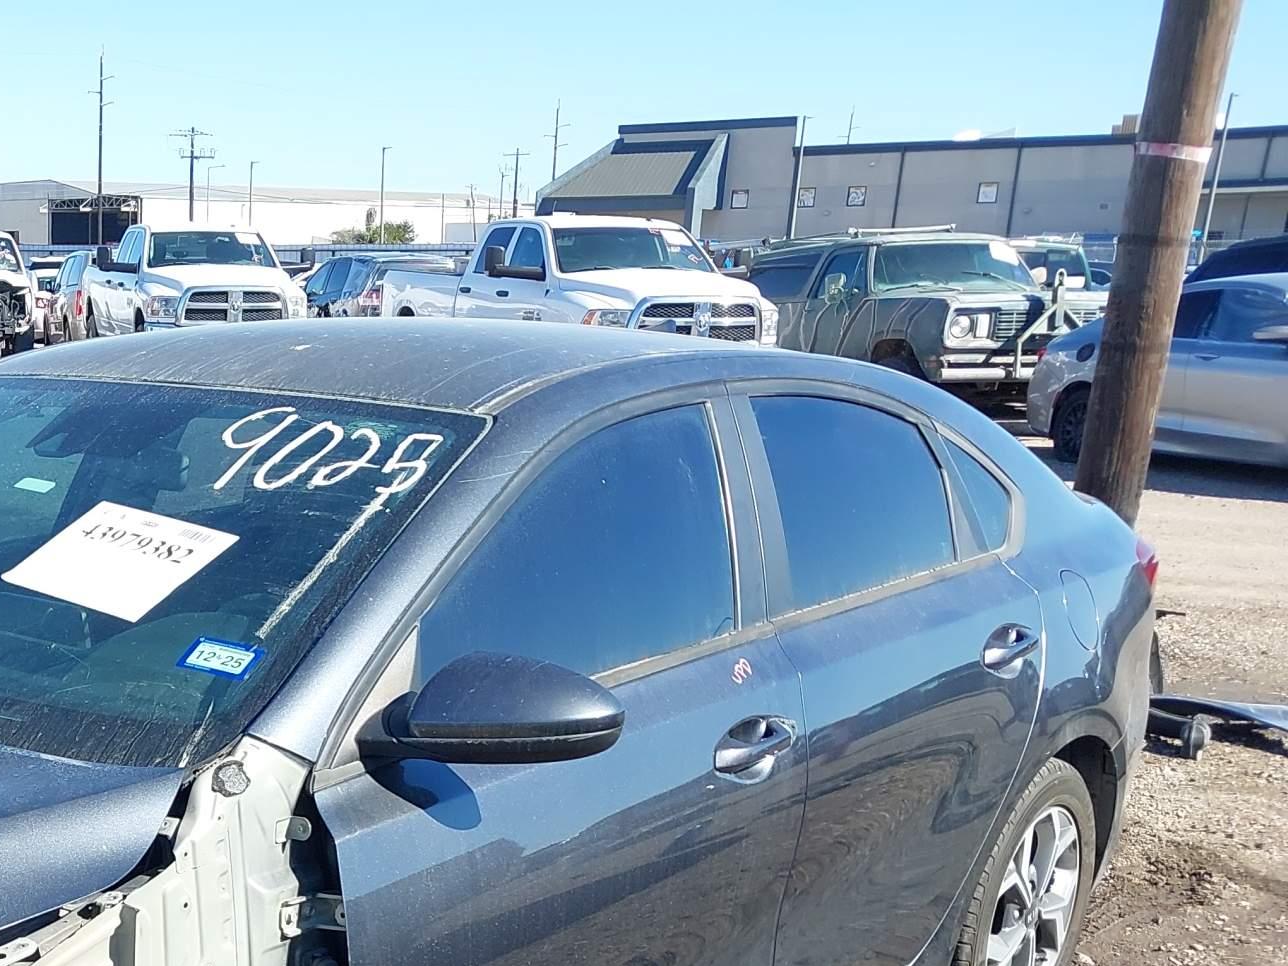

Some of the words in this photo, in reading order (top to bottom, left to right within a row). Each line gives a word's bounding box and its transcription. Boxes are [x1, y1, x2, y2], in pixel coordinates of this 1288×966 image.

[82, 523, 194, 564] 43979382
[196, 650, 217, 662] 12
[220, 655, 245, 668] 25
